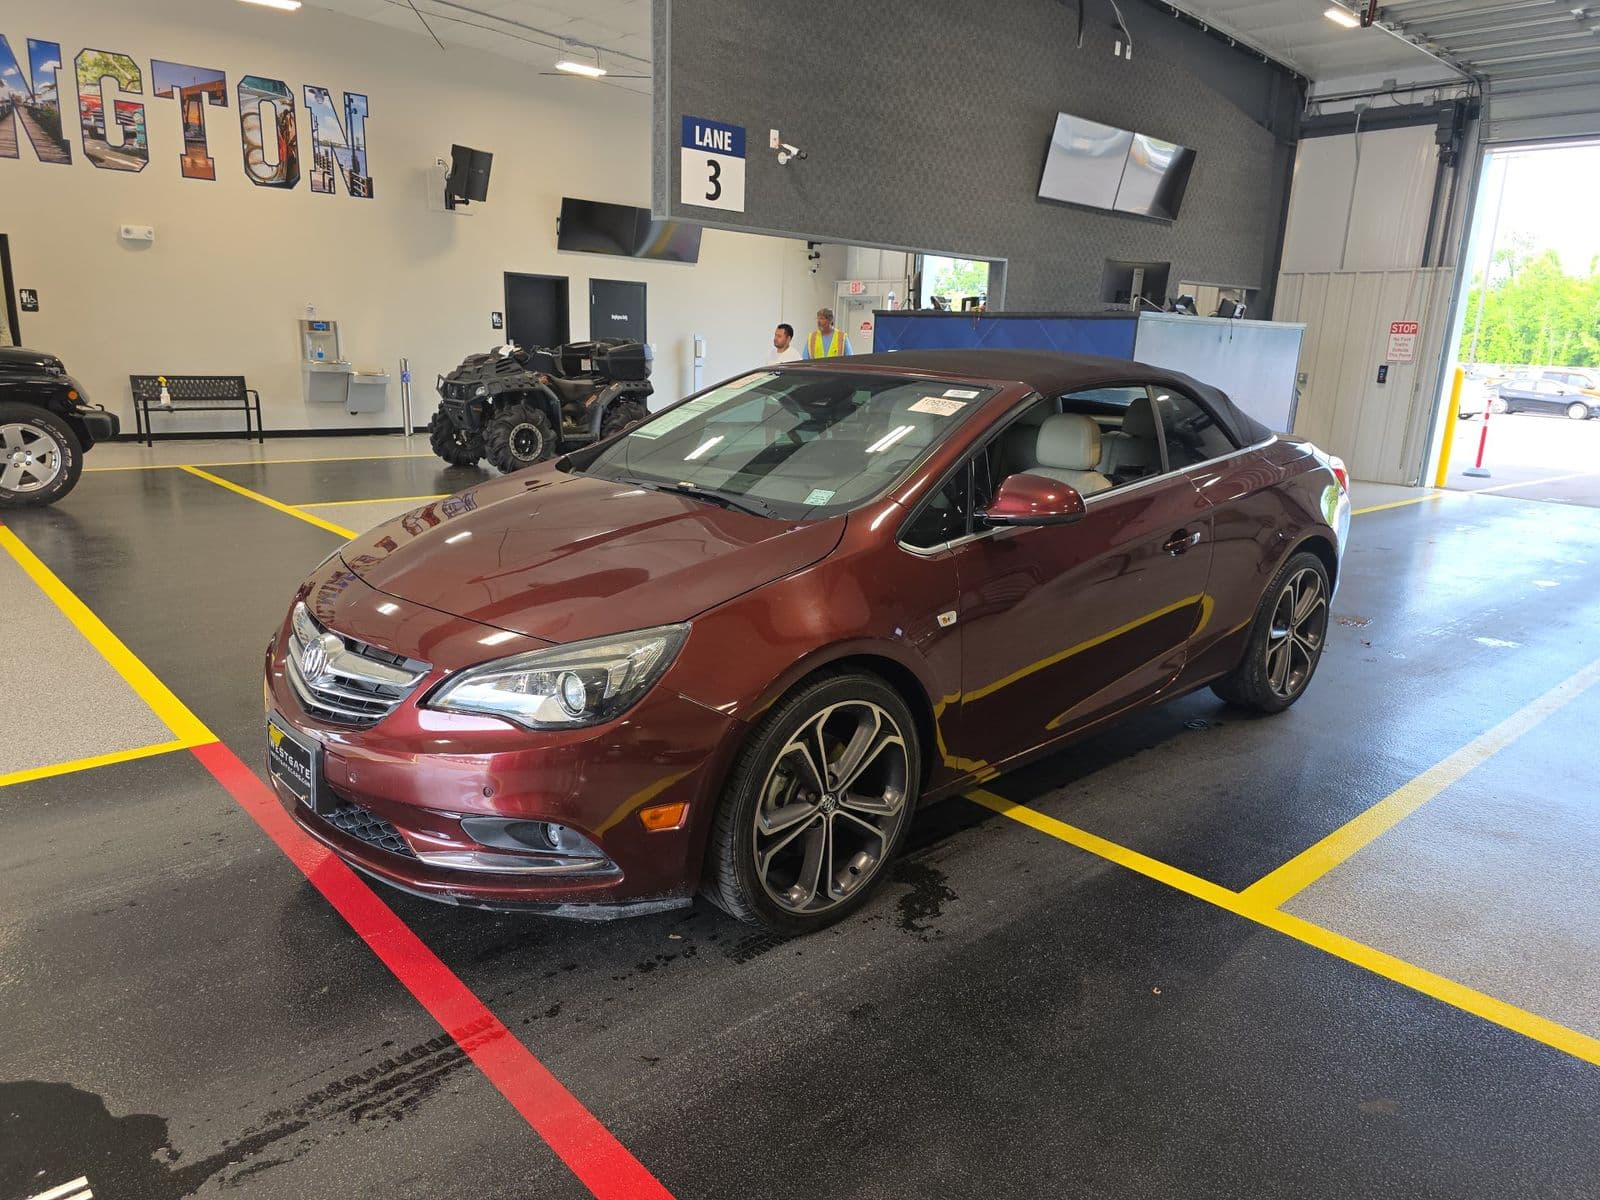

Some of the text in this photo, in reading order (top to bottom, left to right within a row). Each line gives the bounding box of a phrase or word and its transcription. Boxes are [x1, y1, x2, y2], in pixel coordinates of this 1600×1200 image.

[695, 125, 732, 152] LANE
[705, 159, 721, 201] 3
[1391, 323, 1417, 333] STOP
[270, 739, 311, 780] WESTGATE
